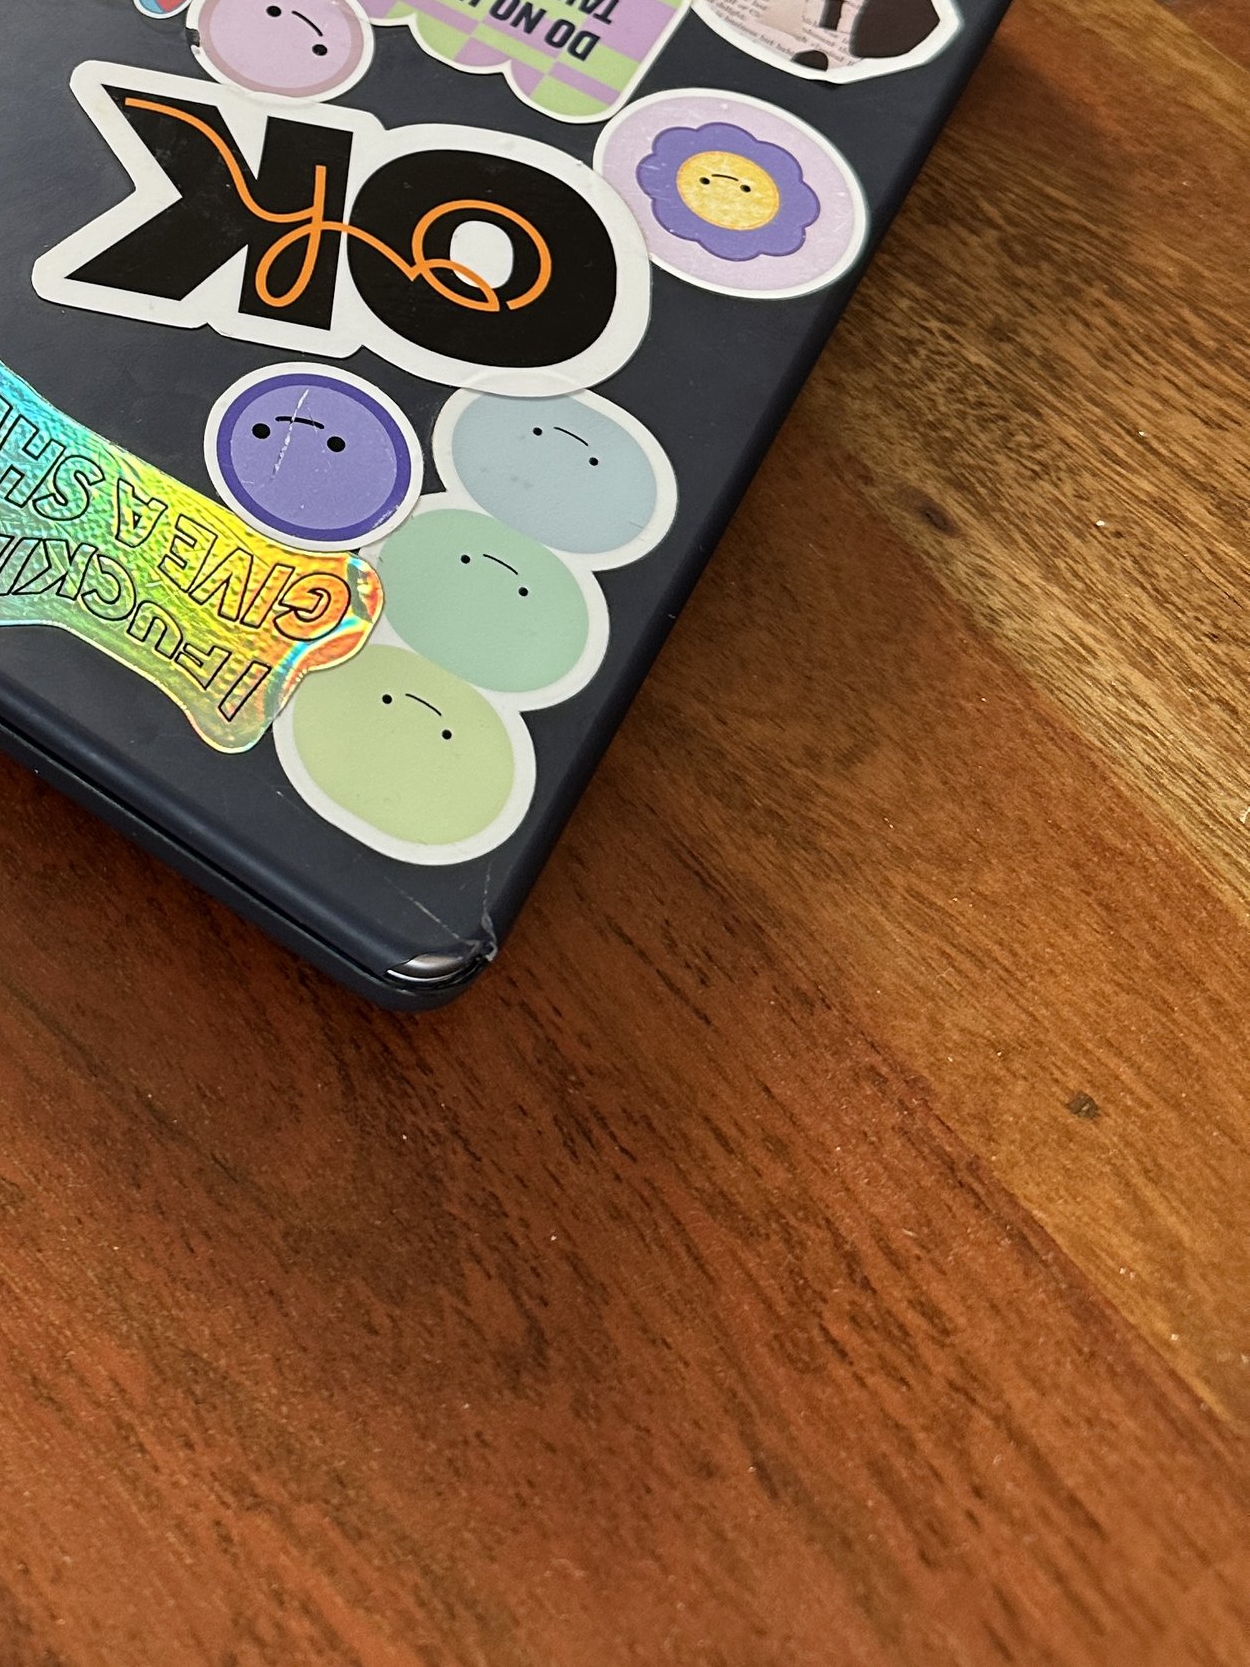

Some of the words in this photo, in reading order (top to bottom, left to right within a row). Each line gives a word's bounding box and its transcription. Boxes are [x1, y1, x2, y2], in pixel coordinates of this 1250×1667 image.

[544, 18, 600, 62] DO
[64, 83, 618, 369] OK
[113, 478, 168, 548] A
[158, 513, 352, 642] GIVE
[218, 659, 272, 722] I
